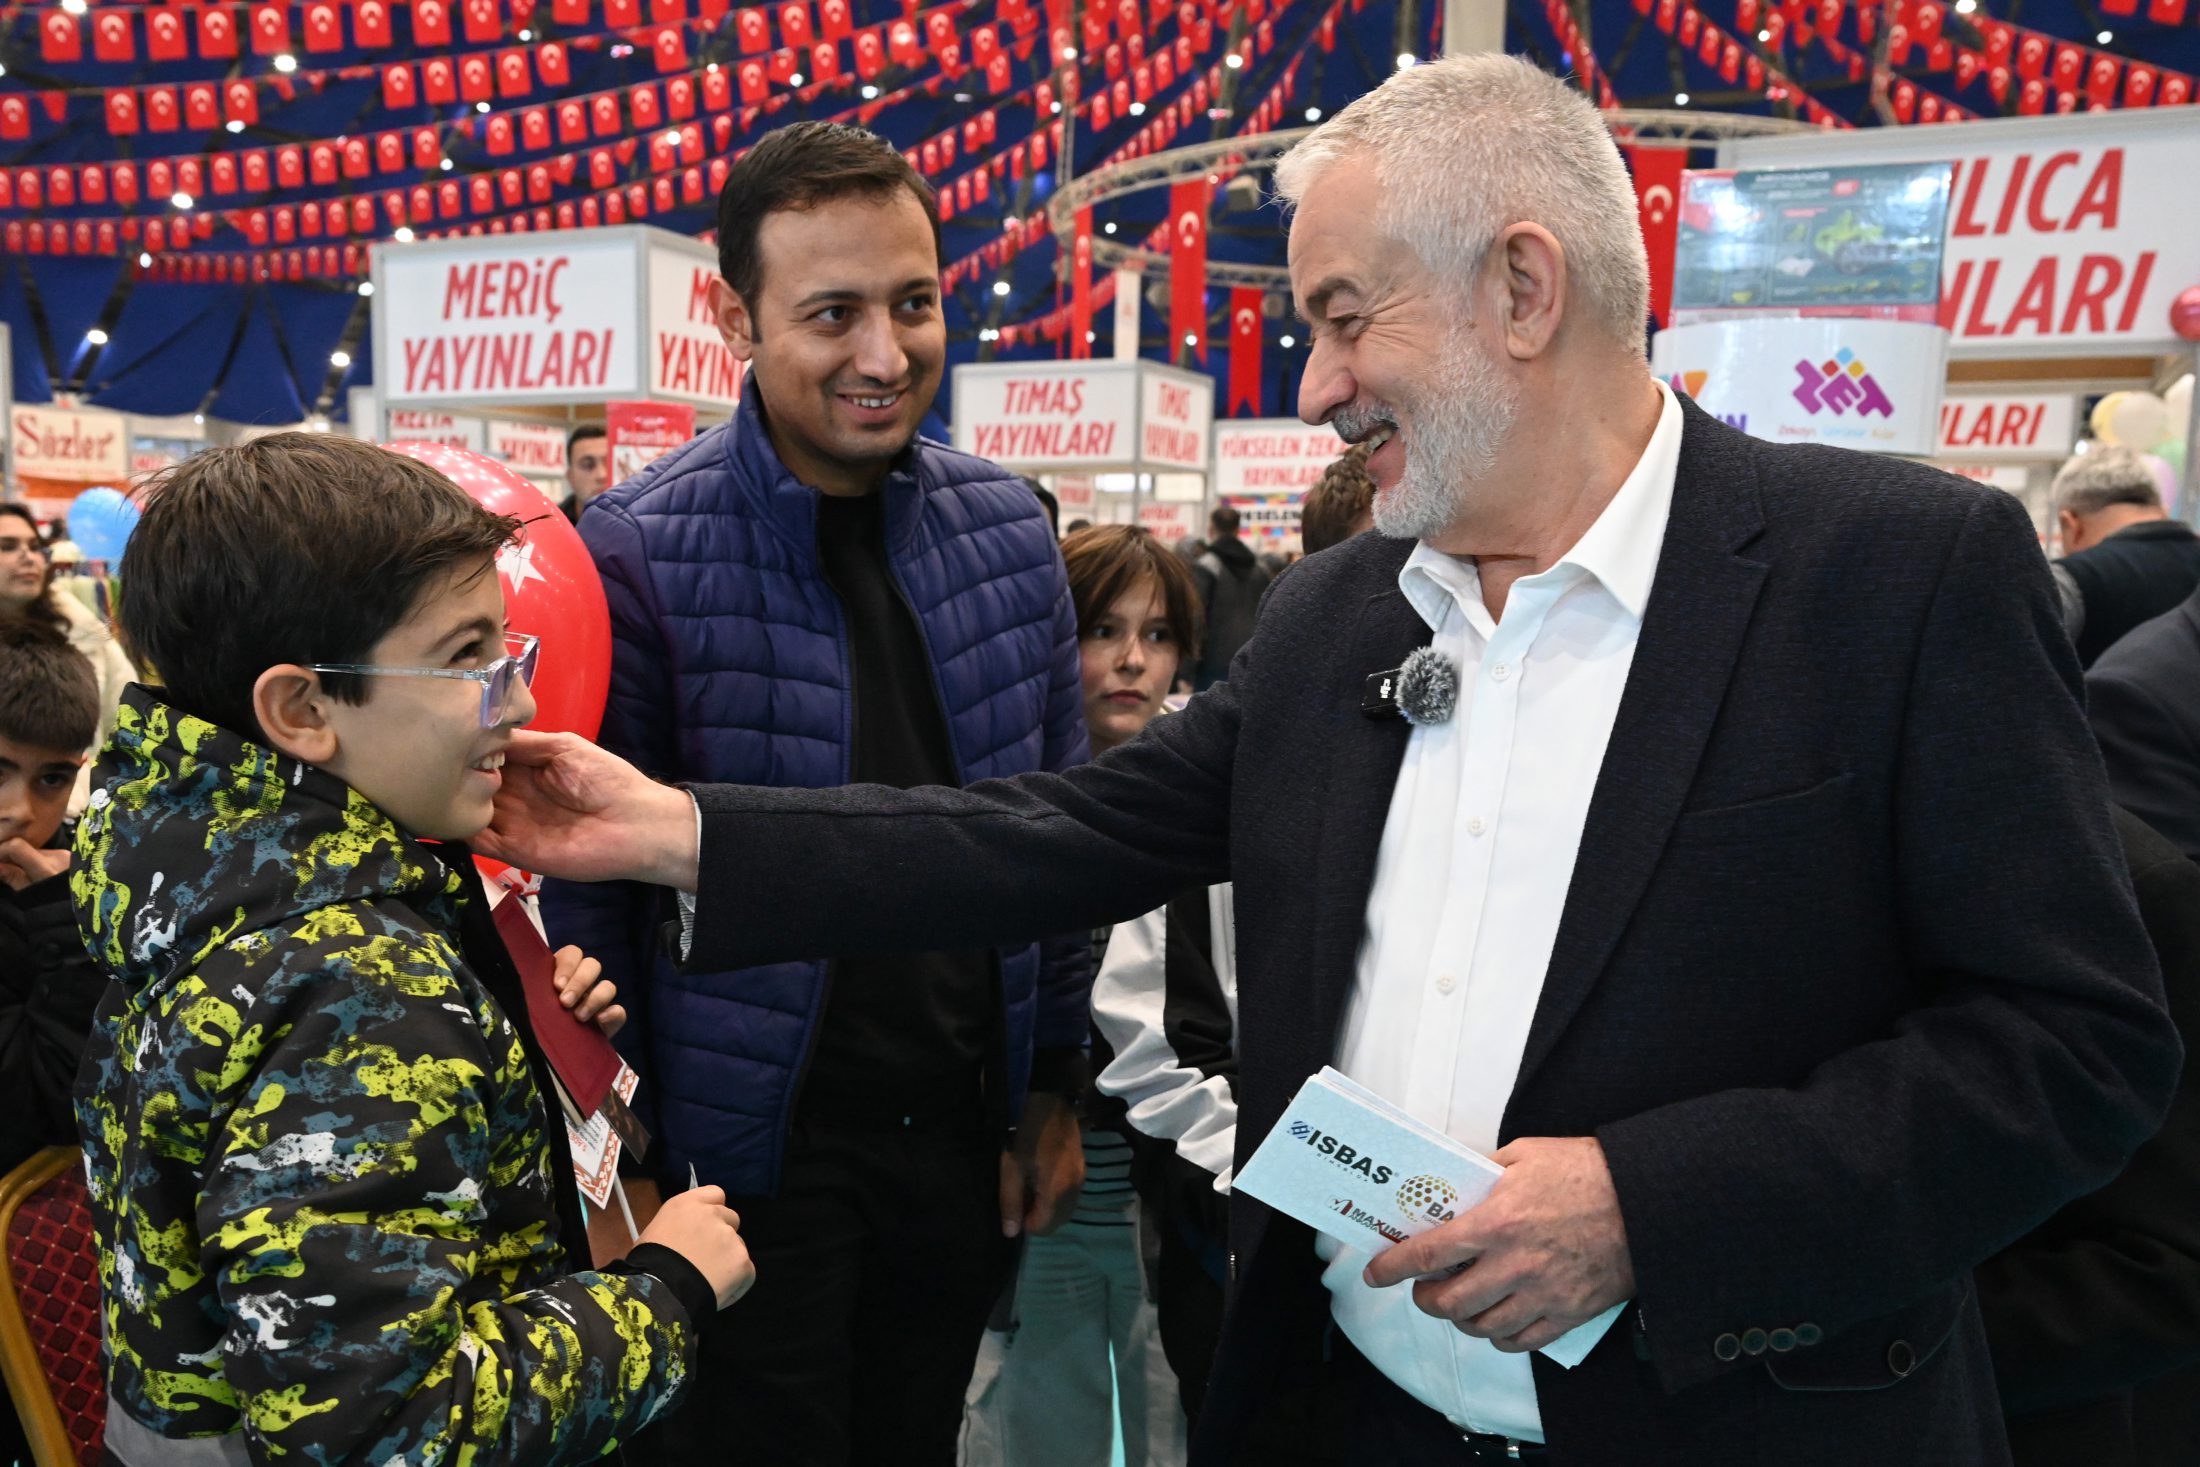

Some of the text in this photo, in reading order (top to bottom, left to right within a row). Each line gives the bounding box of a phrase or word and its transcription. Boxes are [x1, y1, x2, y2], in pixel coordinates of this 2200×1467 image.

[404, 327, 614, 392] YAYINLARI
[15, 413, 115, 460] Sözler
[974, 421, 1116, 458] YAYINLARI
[1243, 466, 1324, 487] YAYINLAR
[1307, 1129, 1393, 1185] ISBAŞ
